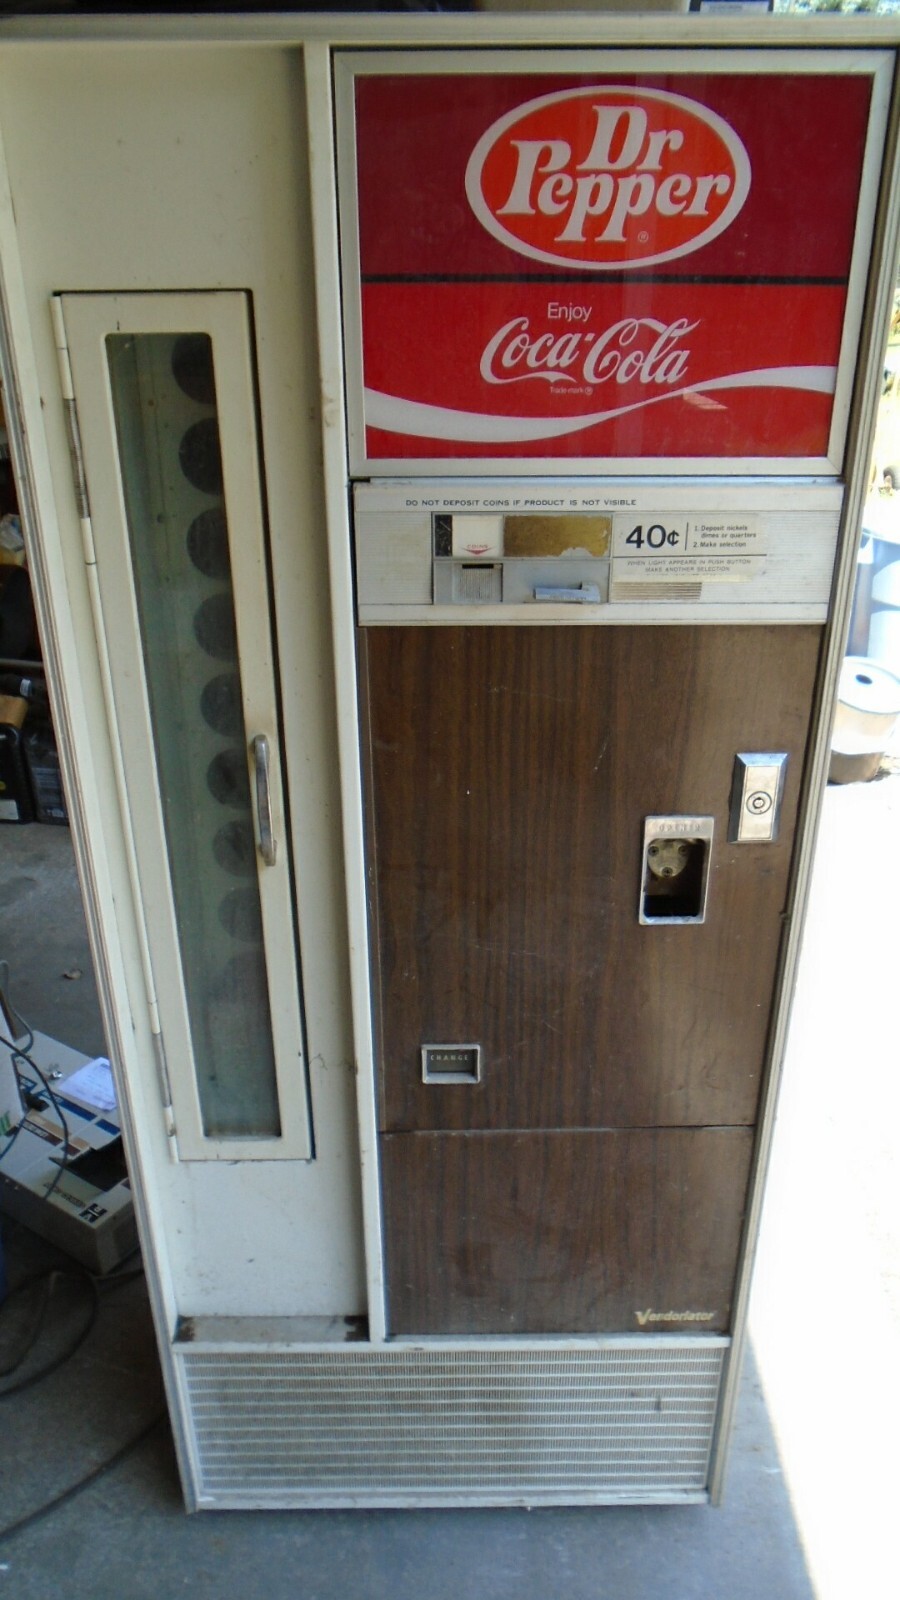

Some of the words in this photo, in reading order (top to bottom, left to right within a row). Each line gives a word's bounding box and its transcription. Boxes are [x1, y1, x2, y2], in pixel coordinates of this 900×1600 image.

[576, 105, 684, 171] Dr
[495, 140, 731, 242] Pepper
[547, 302, 592, 322] Enjoy
[479, 316, 702, 385] Coca-Cola
[625, 524, 680, 549] 40¢
